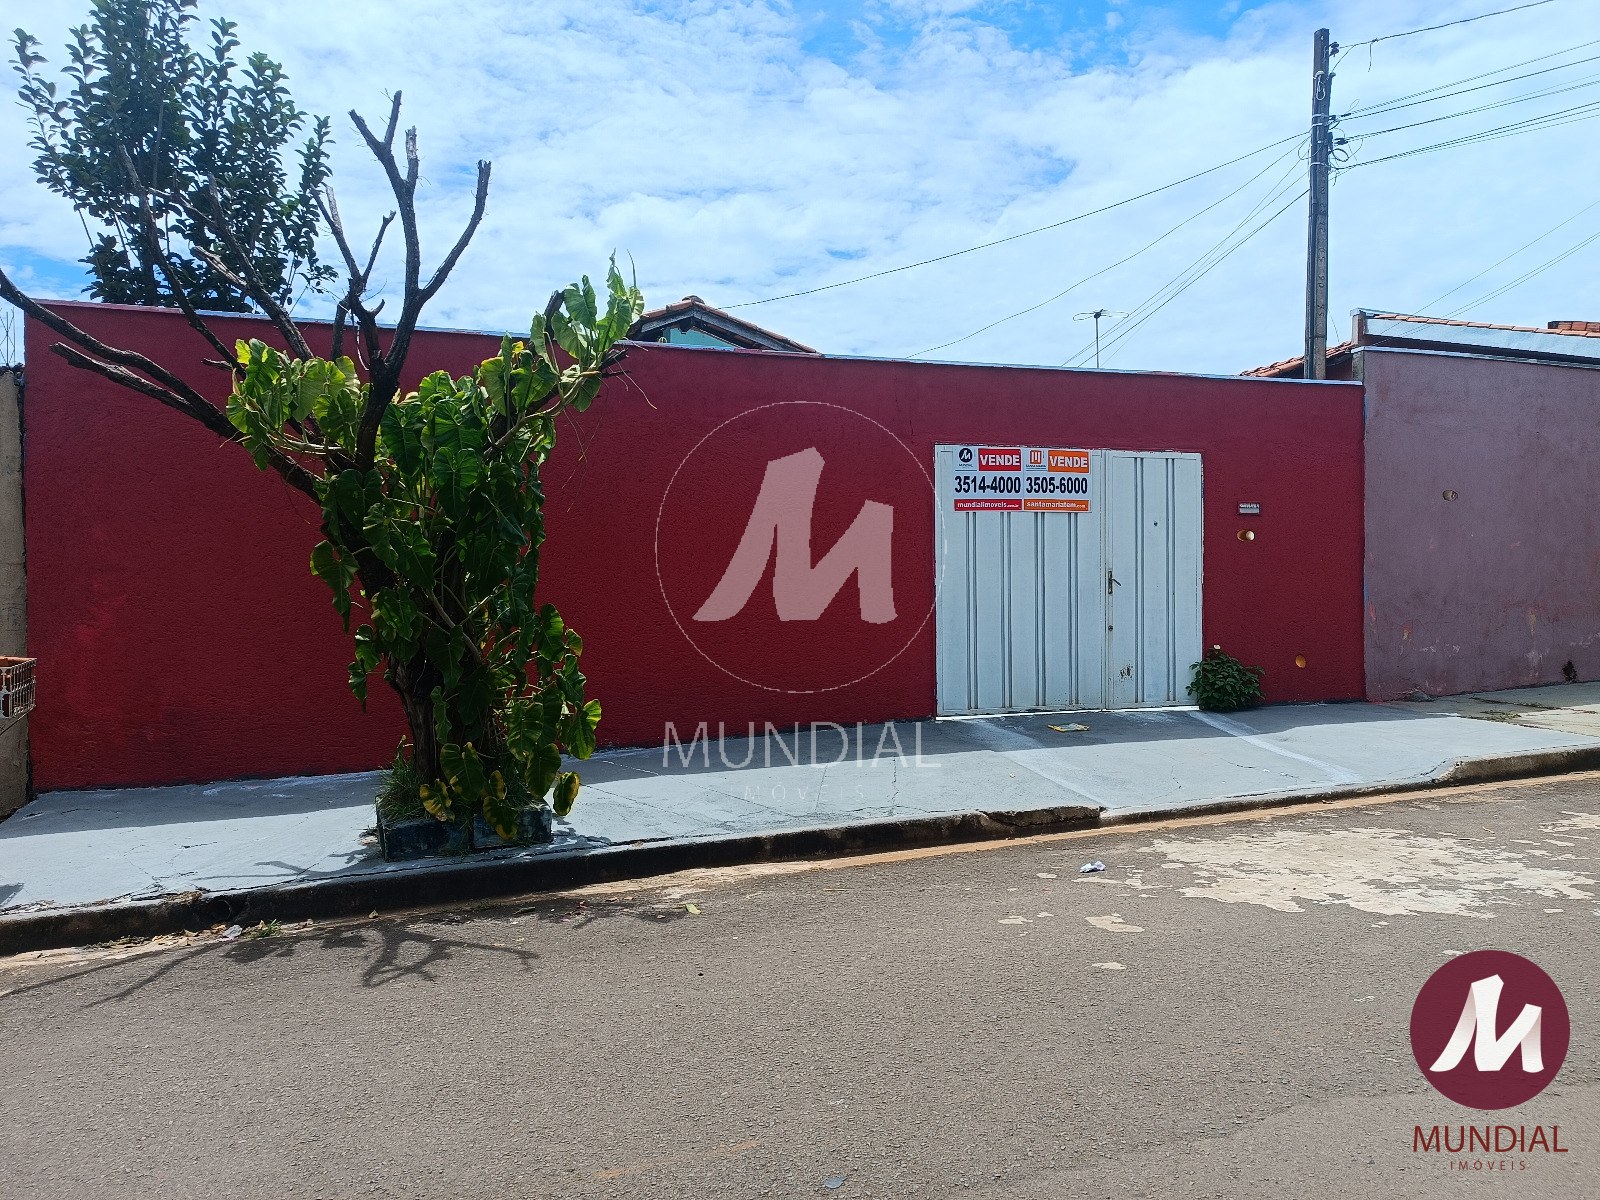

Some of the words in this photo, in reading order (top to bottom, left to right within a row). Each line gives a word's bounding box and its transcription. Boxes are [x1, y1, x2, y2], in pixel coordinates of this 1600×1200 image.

[979, 454, 1021, 466] VENDE
[1049, 455, 1088, 468] VENDE
[954, 475, 1021, 494] 3514-4000
[1025, 476, 1088, 494] 3505-6000
